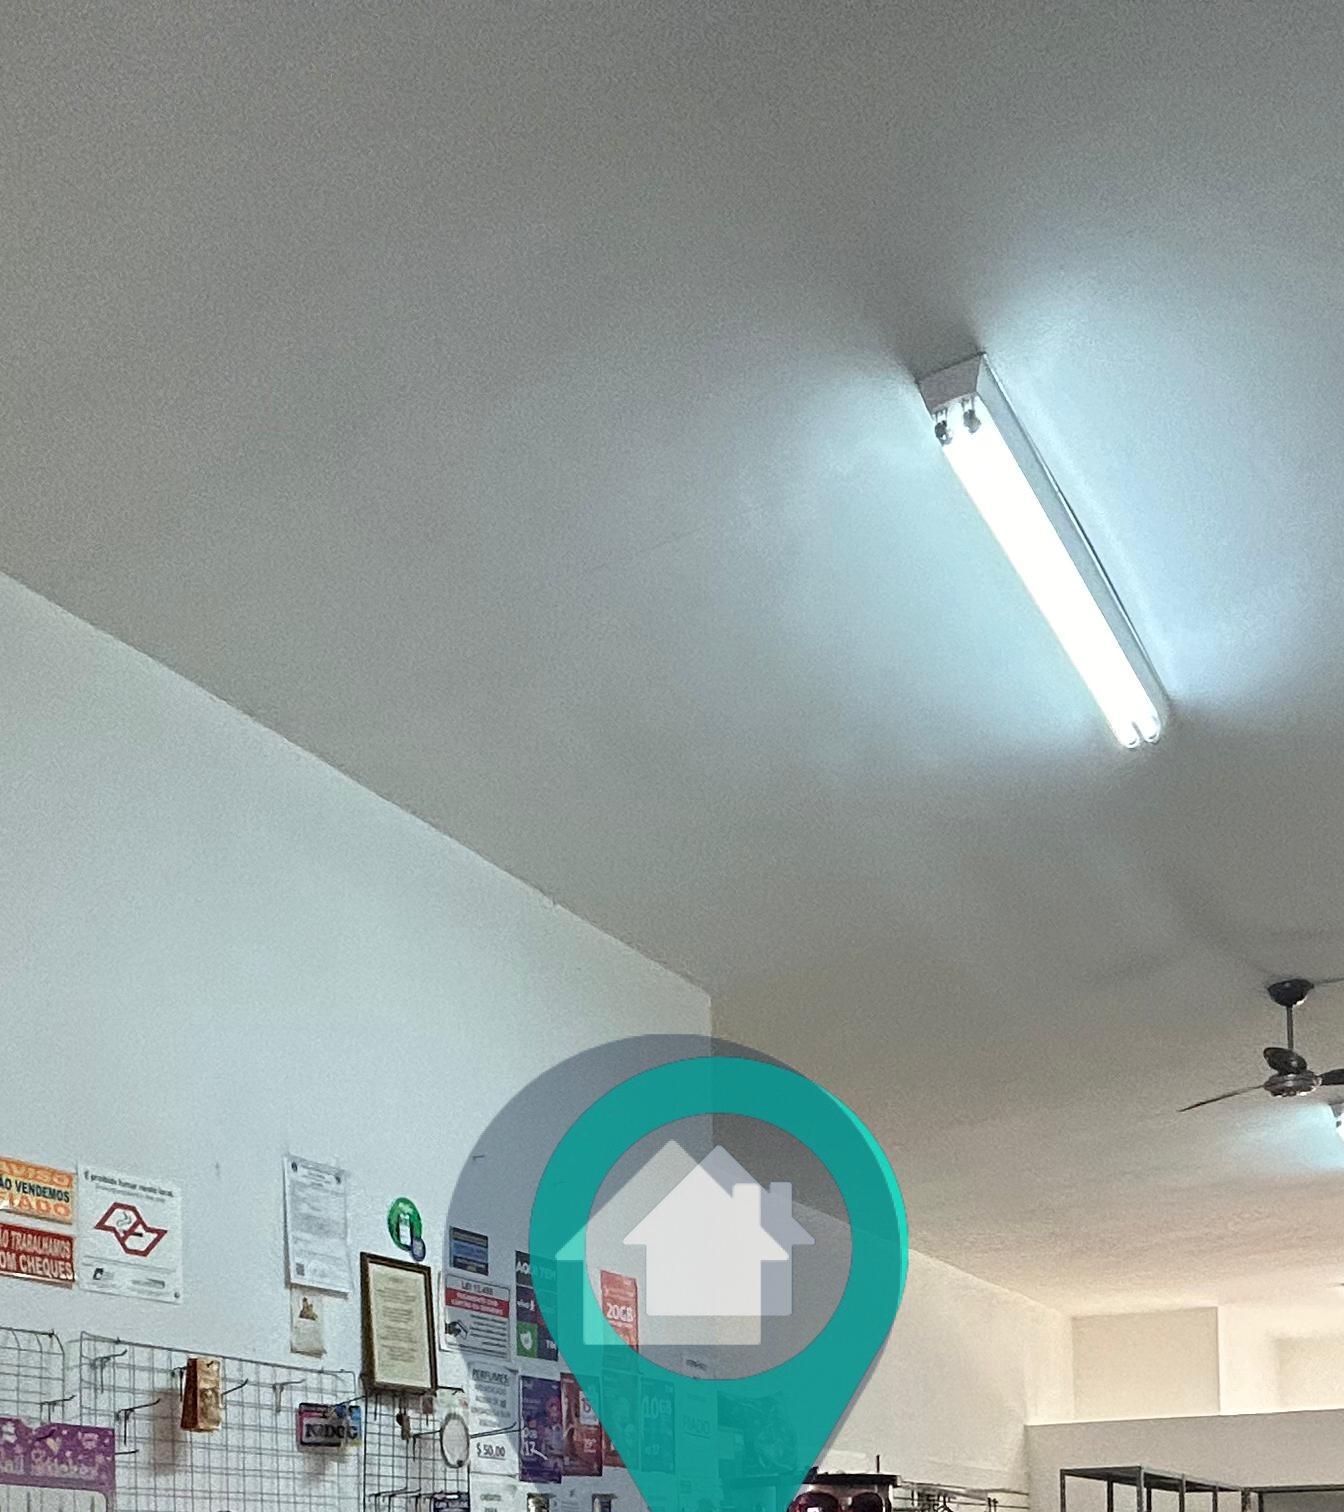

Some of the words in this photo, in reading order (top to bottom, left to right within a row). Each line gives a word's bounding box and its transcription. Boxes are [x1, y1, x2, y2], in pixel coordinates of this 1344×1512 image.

[15, 1180, 70, 1203] VENDEMOS
[10, 1232, 71, 1259] TRABALHAMOS
[20, 1256, 73, 1280] CHEQUES
